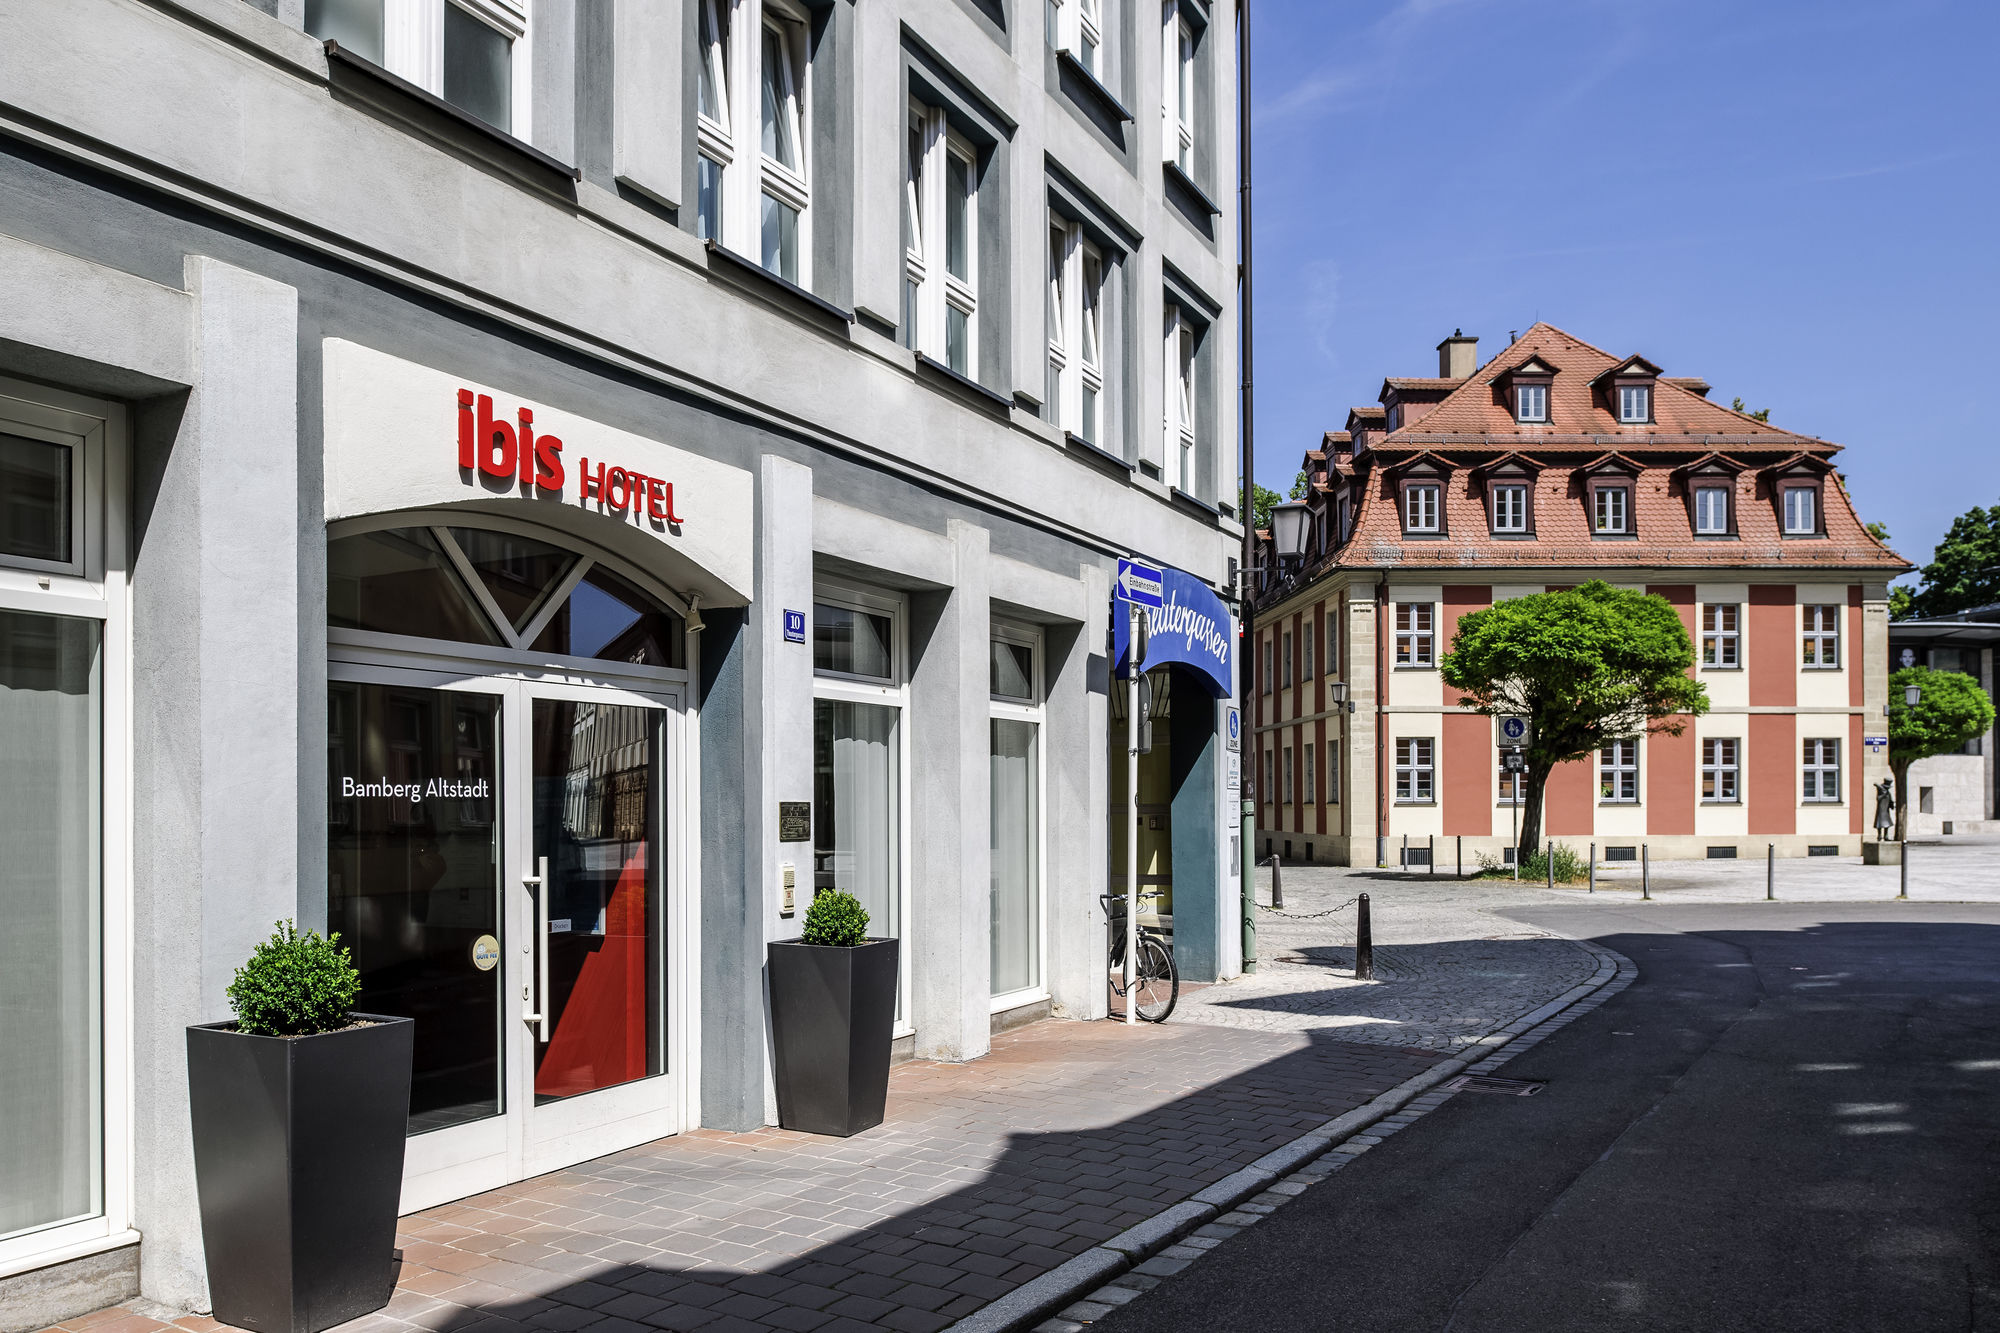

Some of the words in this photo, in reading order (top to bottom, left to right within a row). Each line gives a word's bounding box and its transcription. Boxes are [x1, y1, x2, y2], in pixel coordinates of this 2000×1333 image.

[458, 388, 565, 491] ibis
[580, 457, 684, 523] HOTEL
[790, 614, 801, 630] 10
[342, 776, 421, 803] Bamberg
[425, 777, 489, 798] Altstadt
